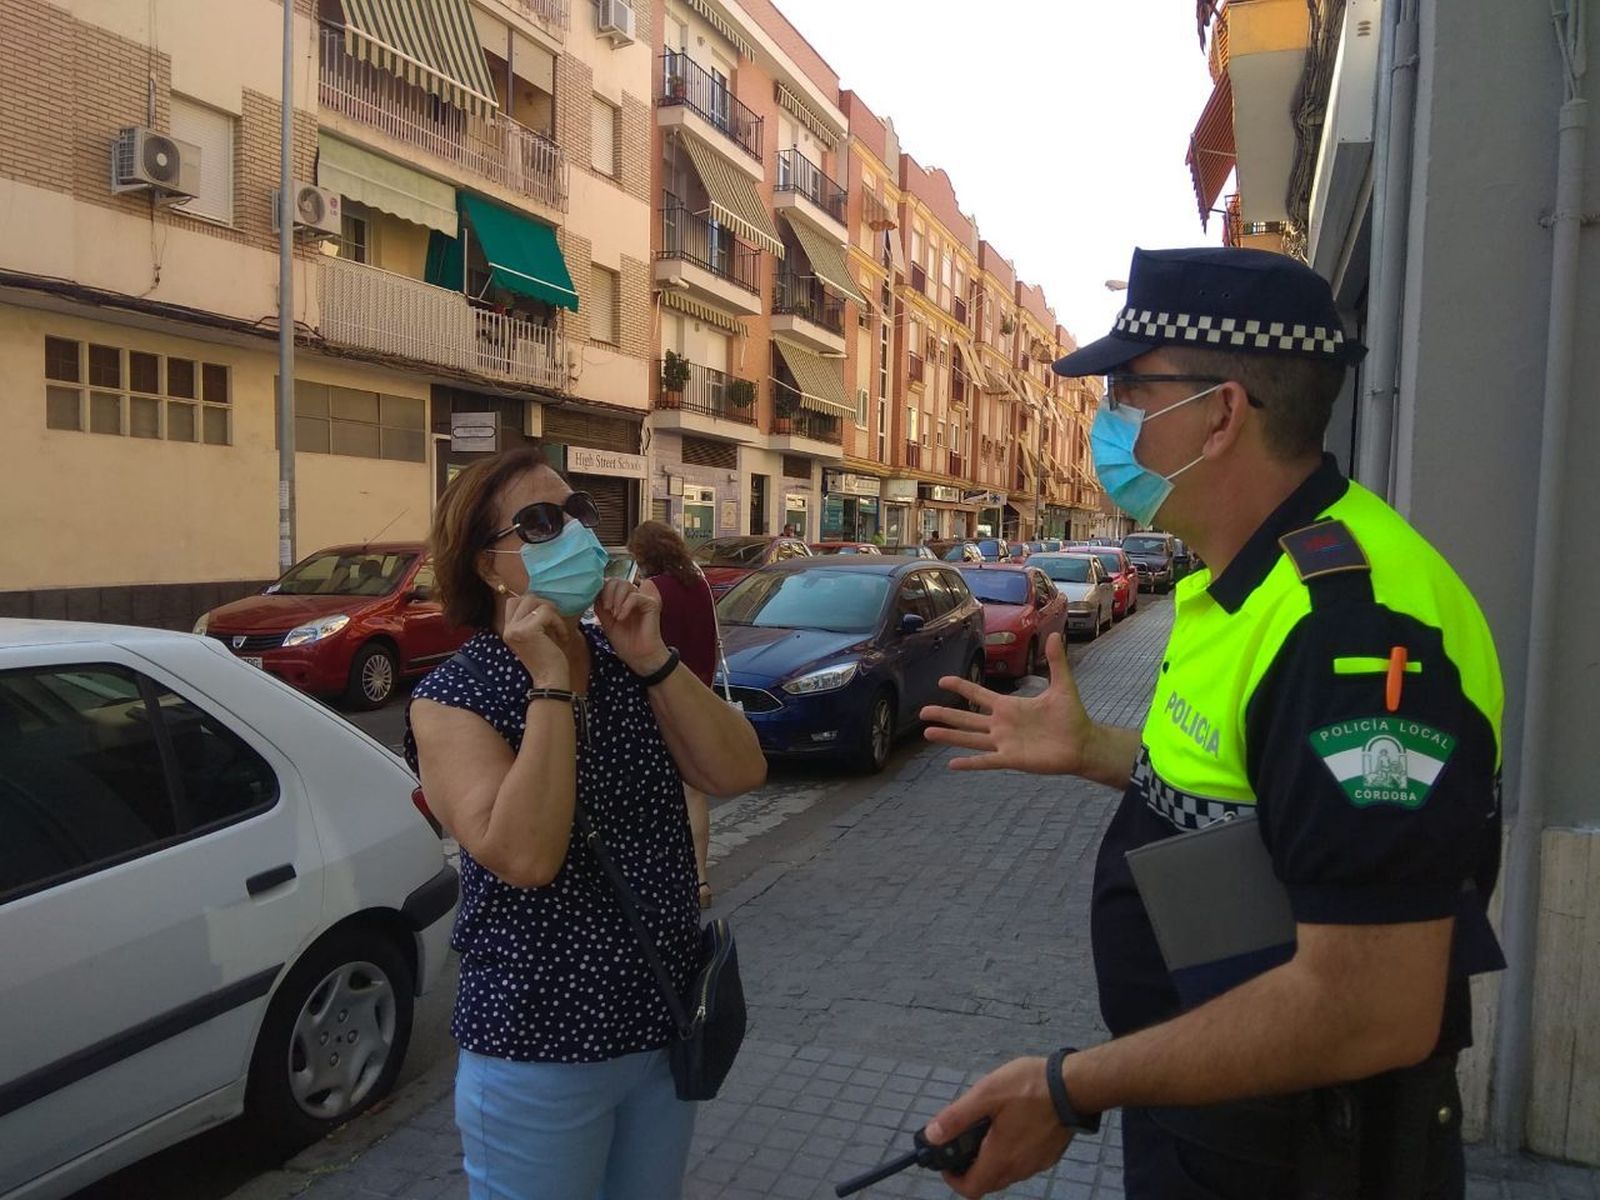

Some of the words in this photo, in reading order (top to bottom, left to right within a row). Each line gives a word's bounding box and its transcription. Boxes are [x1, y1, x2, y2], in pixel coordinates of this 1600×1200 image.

[575, 452, 594, 469] High
[595, 454, 616, 469] Street
[1164, 690, 1221, 759] POLICIA
[1399, 722, 1449, 749] LOCAL
